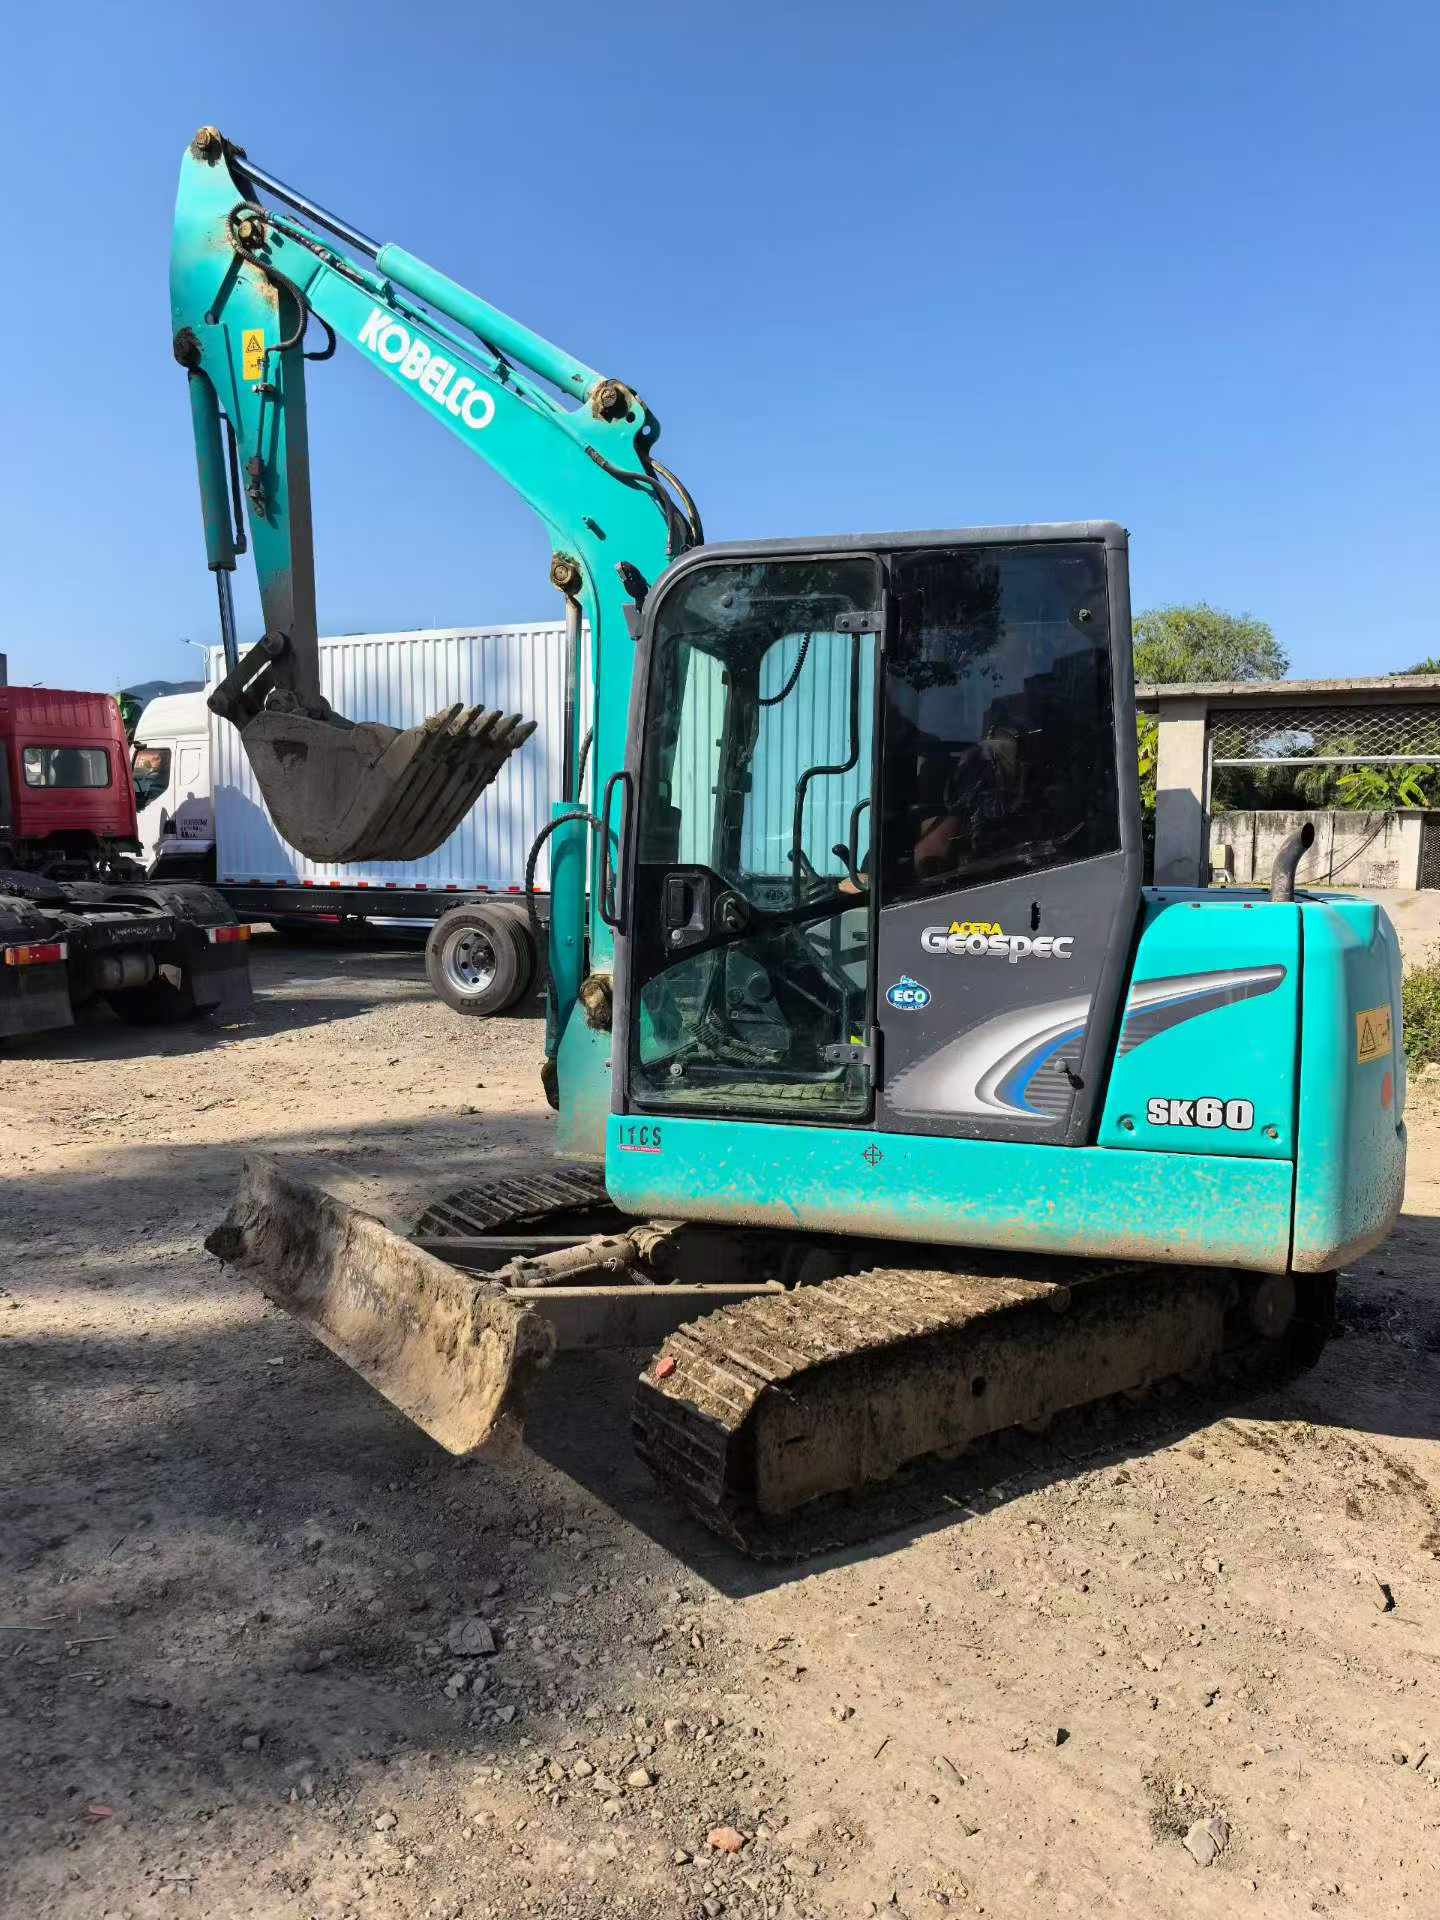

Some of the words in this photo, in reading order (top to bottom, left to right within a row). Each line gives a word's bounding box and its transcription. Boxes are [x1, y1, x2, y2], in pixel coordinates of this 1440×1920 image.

[358, 307, 496, 429] KOBELCO
[948, 921, 1004, 935] ACERA
[894, 989, 926, 1003] ECO
[1147, 1097, 1254, 1130] SK60
